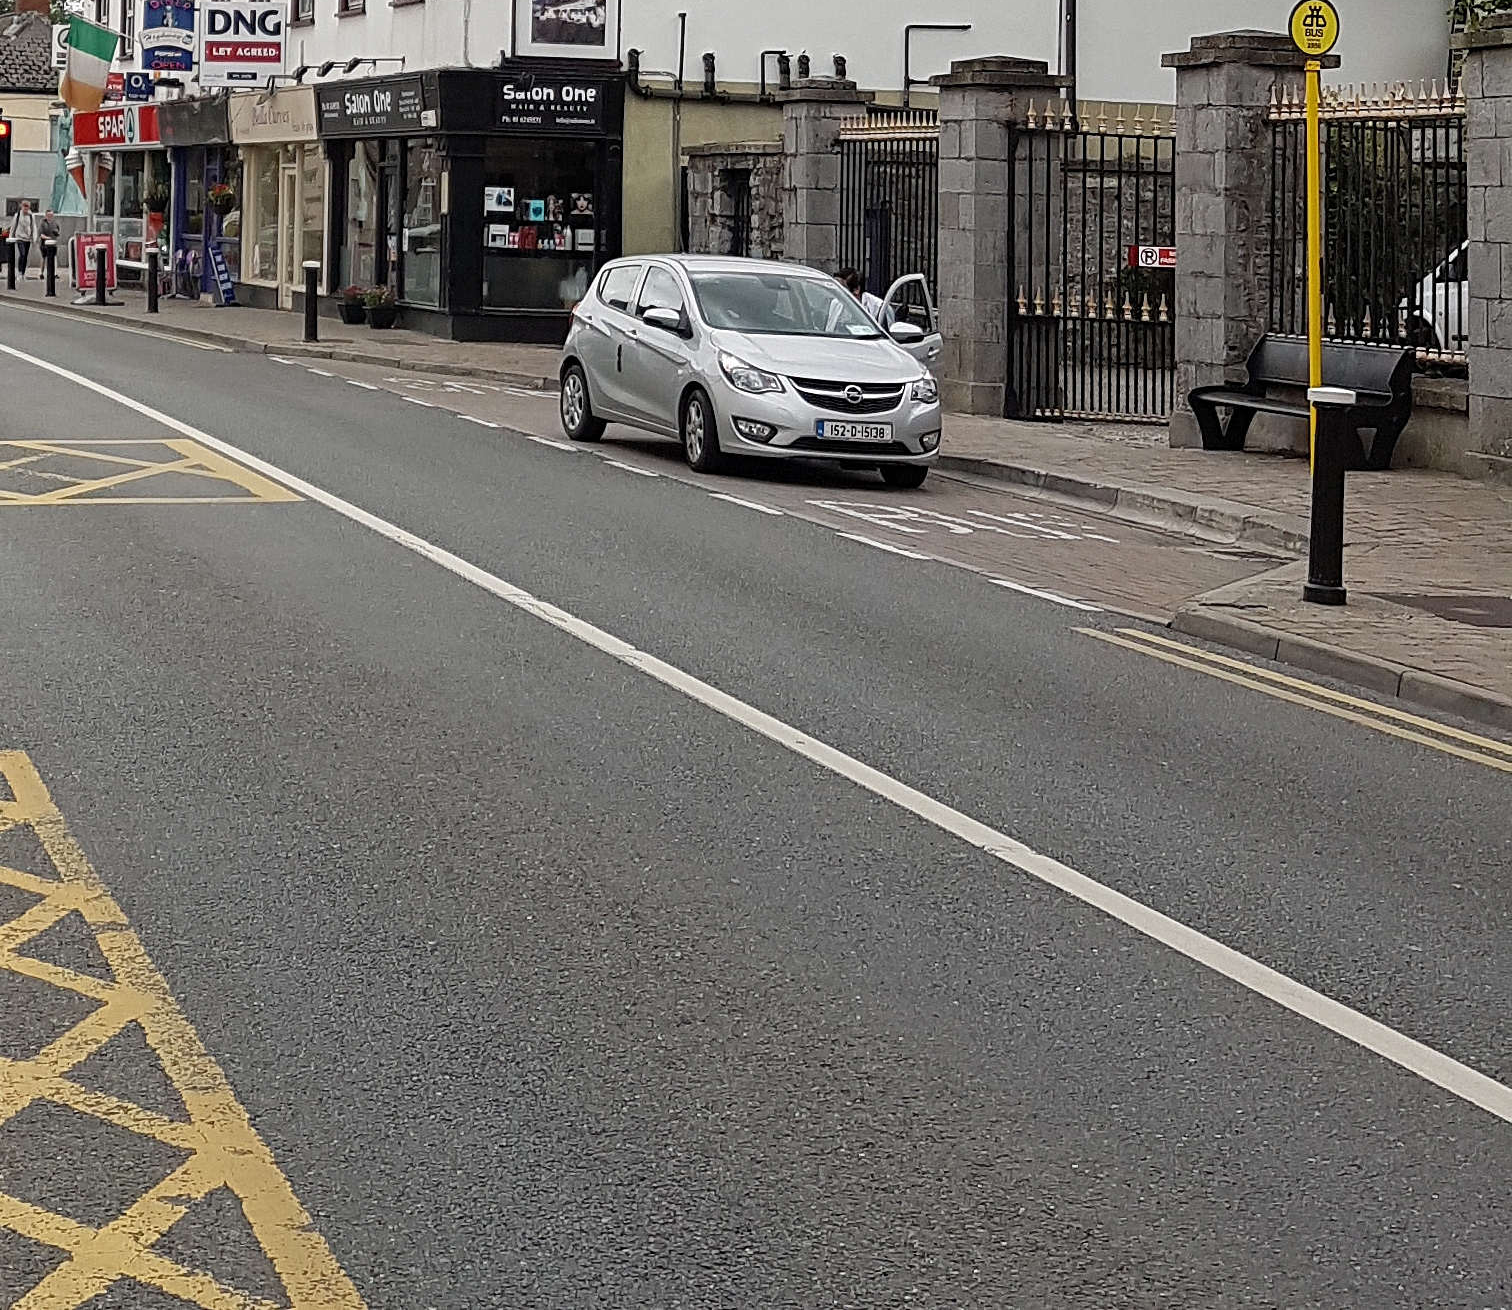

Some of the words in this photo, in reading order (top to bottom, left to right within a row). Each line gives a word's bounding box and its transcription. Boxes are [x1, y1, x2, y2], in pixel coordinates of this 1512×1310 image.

[207, 9, 281, 37] DNG
[1305, 28, 1324, 38] BUS
[212, 47, 233, 56] LET
[236, 47, 277, 57] AGREED
[151, 60, 186, 70] OPEN
[503, 84, 554, 101] Salon
[561, 86, 596, 102] One
[344, 93, 371, 115] Salon
[373, 90, 392, 113] One
[98, 114, 126, 139] SPAR
[830, 424, 885, 439] 152-D-15138
